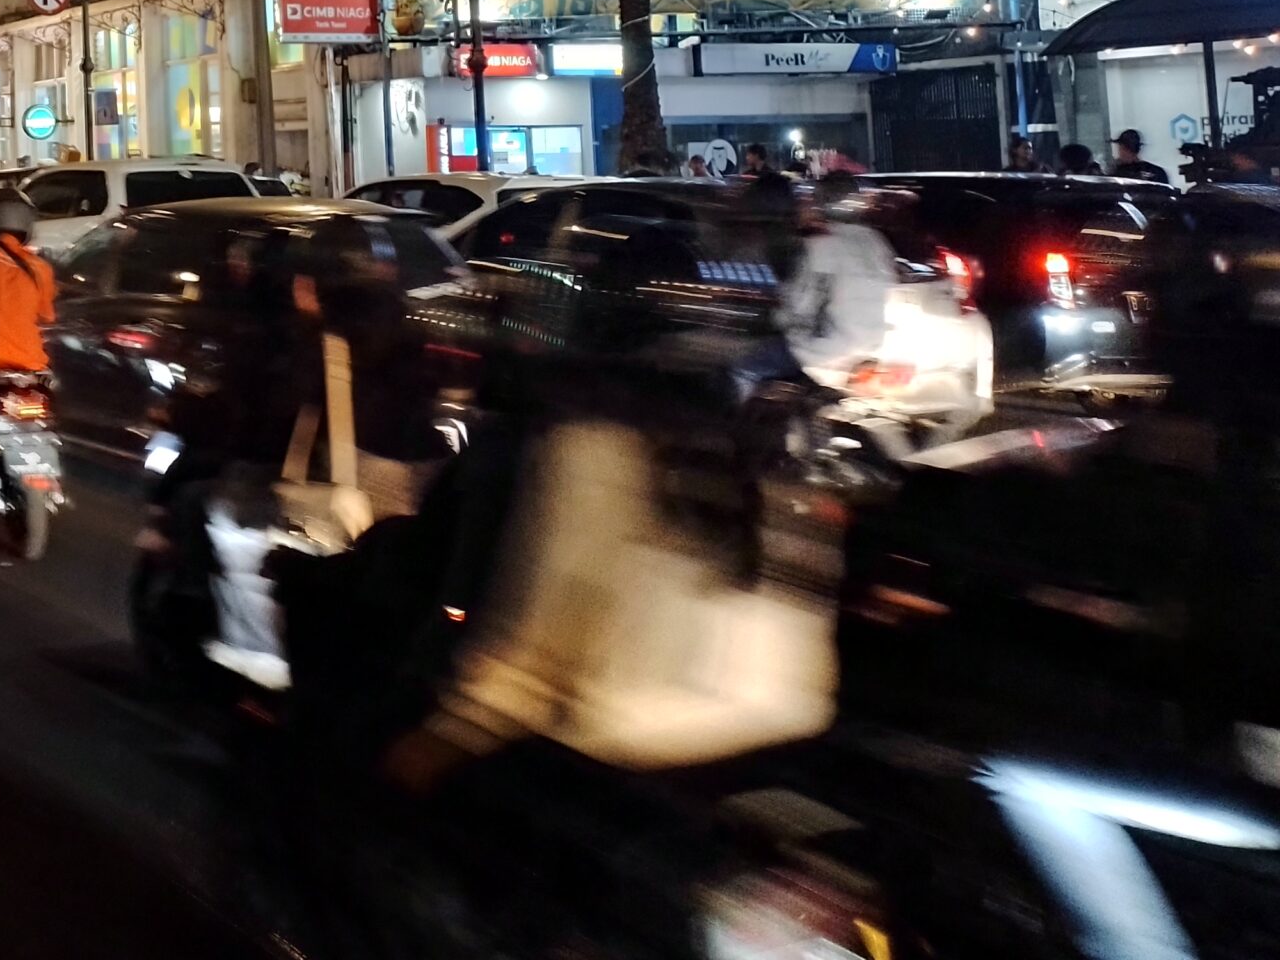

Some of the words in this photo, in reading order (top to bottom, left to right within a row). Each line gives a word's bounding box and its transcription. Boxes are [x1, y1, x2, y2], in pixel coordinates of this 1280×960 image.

[303, 6, 336, 18] CIMB
[336, 6, 373, 19] NIAGA
[501, 54, 533, 66] NIAGA
[764, 52, 806, 67] PeeR
